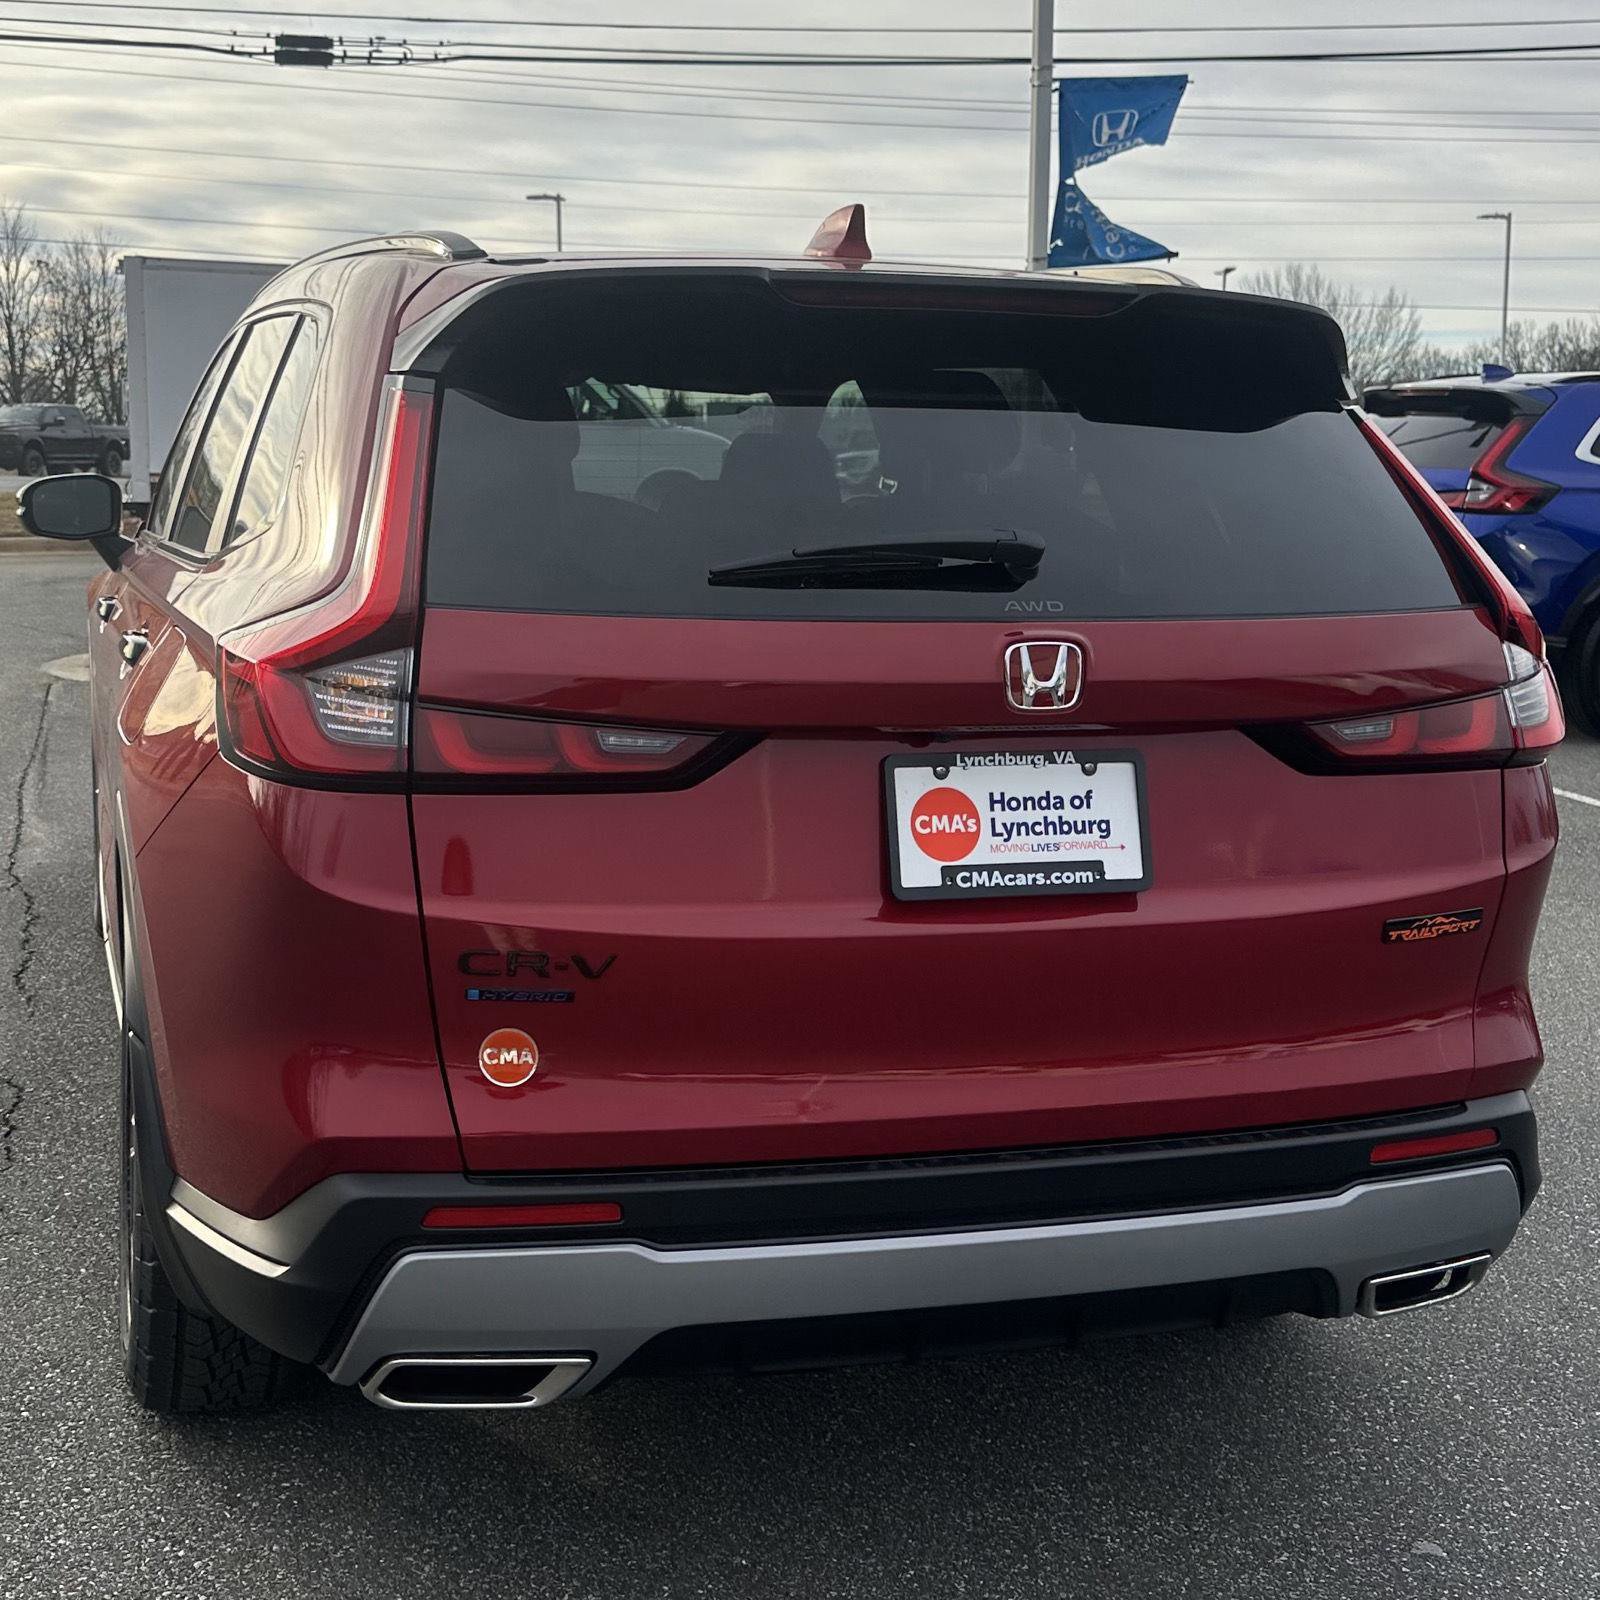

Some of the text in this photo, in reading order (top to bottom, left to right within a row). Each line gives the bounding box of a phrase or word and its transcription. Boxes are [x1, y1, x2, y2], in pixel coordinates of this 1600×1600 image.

[1004, 600, 1064, 612] AWD
[1053, 750, 1076, 764] VA
[989, 789, 1093, 812] Honda of
[914, 814, 978, 835] CMA's
[990, 815, 1111, 842] Lynchburg
[956, 870, 1094, 888] CMAcars.com
[1388, 919, 1481, 941] TRAILSPORT
[458, 951, 618, 979] CR-V
[481, 989, 569, 1002] HYBRID
[483, 1048, 534, 1065] CMA
